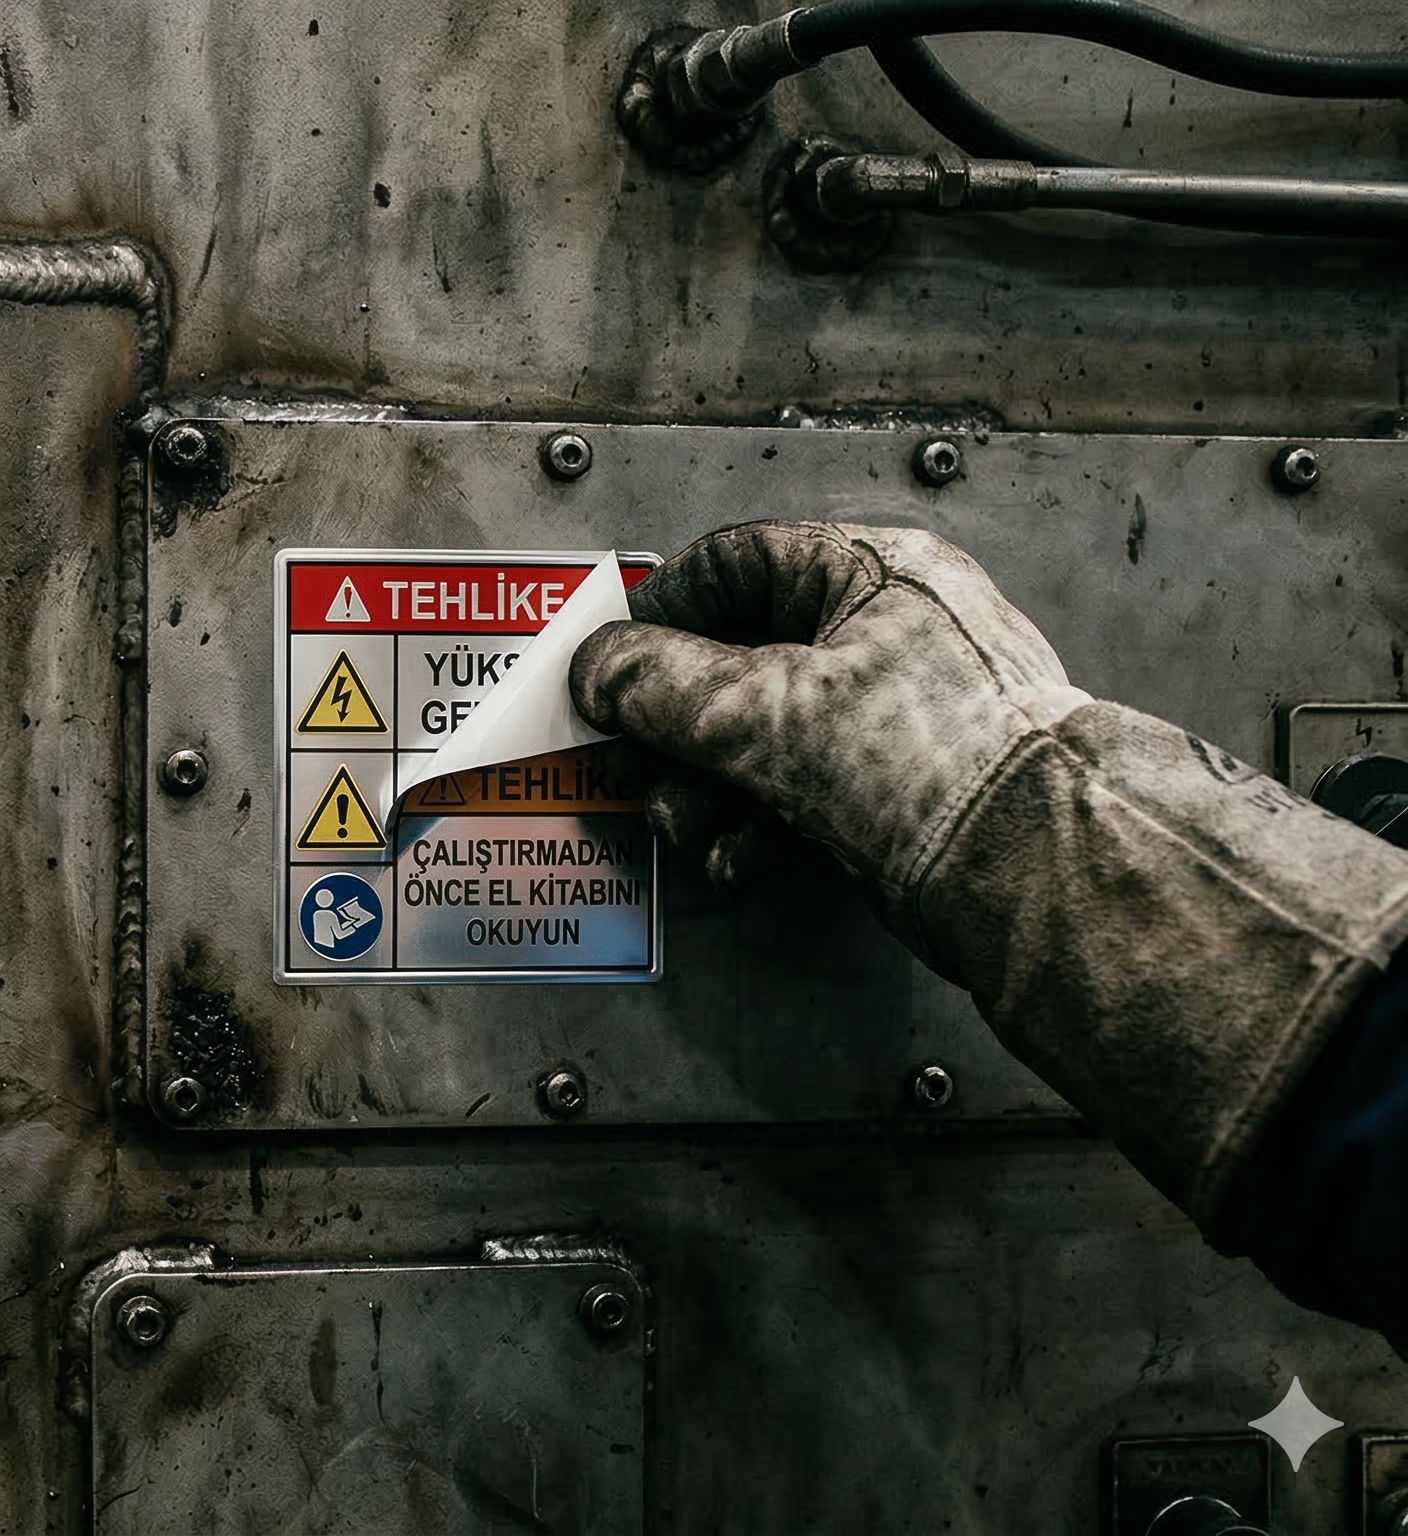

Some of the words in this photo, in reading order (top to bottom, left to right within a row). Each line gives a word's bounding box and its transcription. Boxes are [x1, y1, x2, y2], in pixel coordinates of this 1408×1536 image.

[383, 572, 564, 621] TEHLİKE
[413, 839, 632, 874] ÇALIŞTIRMADAN
[404, 873, 480, 907] ÖNCE
[489, 879, 521, 906] EL
[529, 873, 640, 906] KİTABINI
[467, 918, 579, 946] OKUYUN
